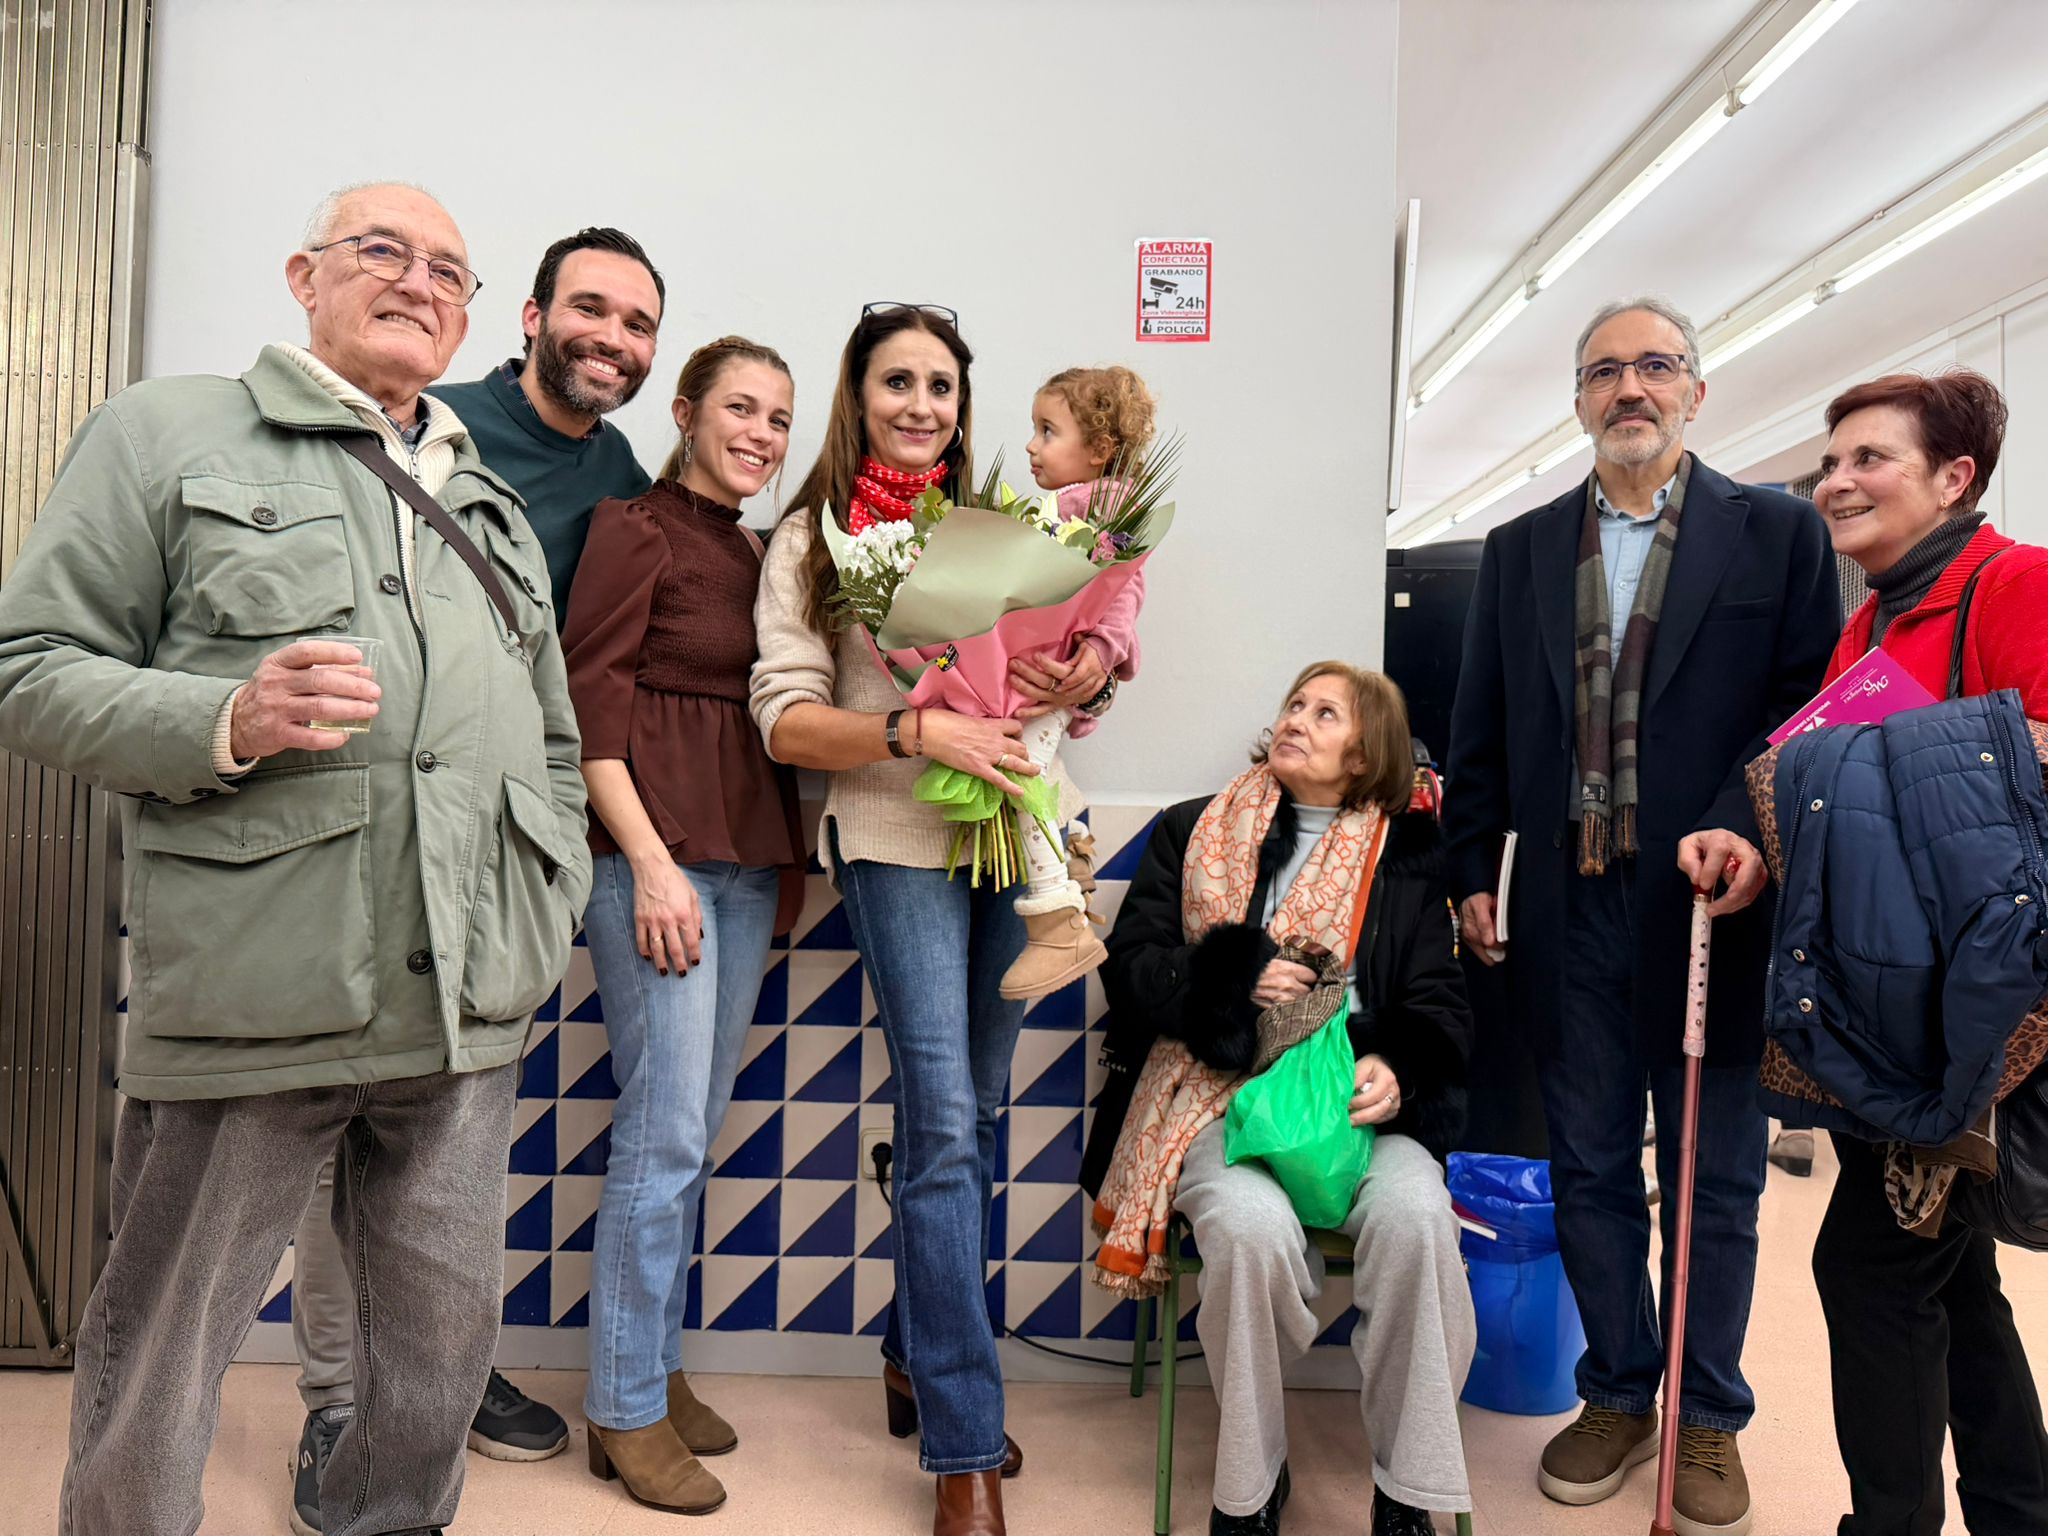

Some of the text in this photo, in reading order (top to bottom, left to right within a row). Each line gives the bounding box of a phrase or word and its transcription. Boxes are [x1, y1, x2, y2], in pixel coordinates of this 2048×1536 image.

[1141, 242, 1207, 253] ALARMA
[1143, 256, 1205, 264] CONECTADA
[1175, 296, 1205, 309] 24h
